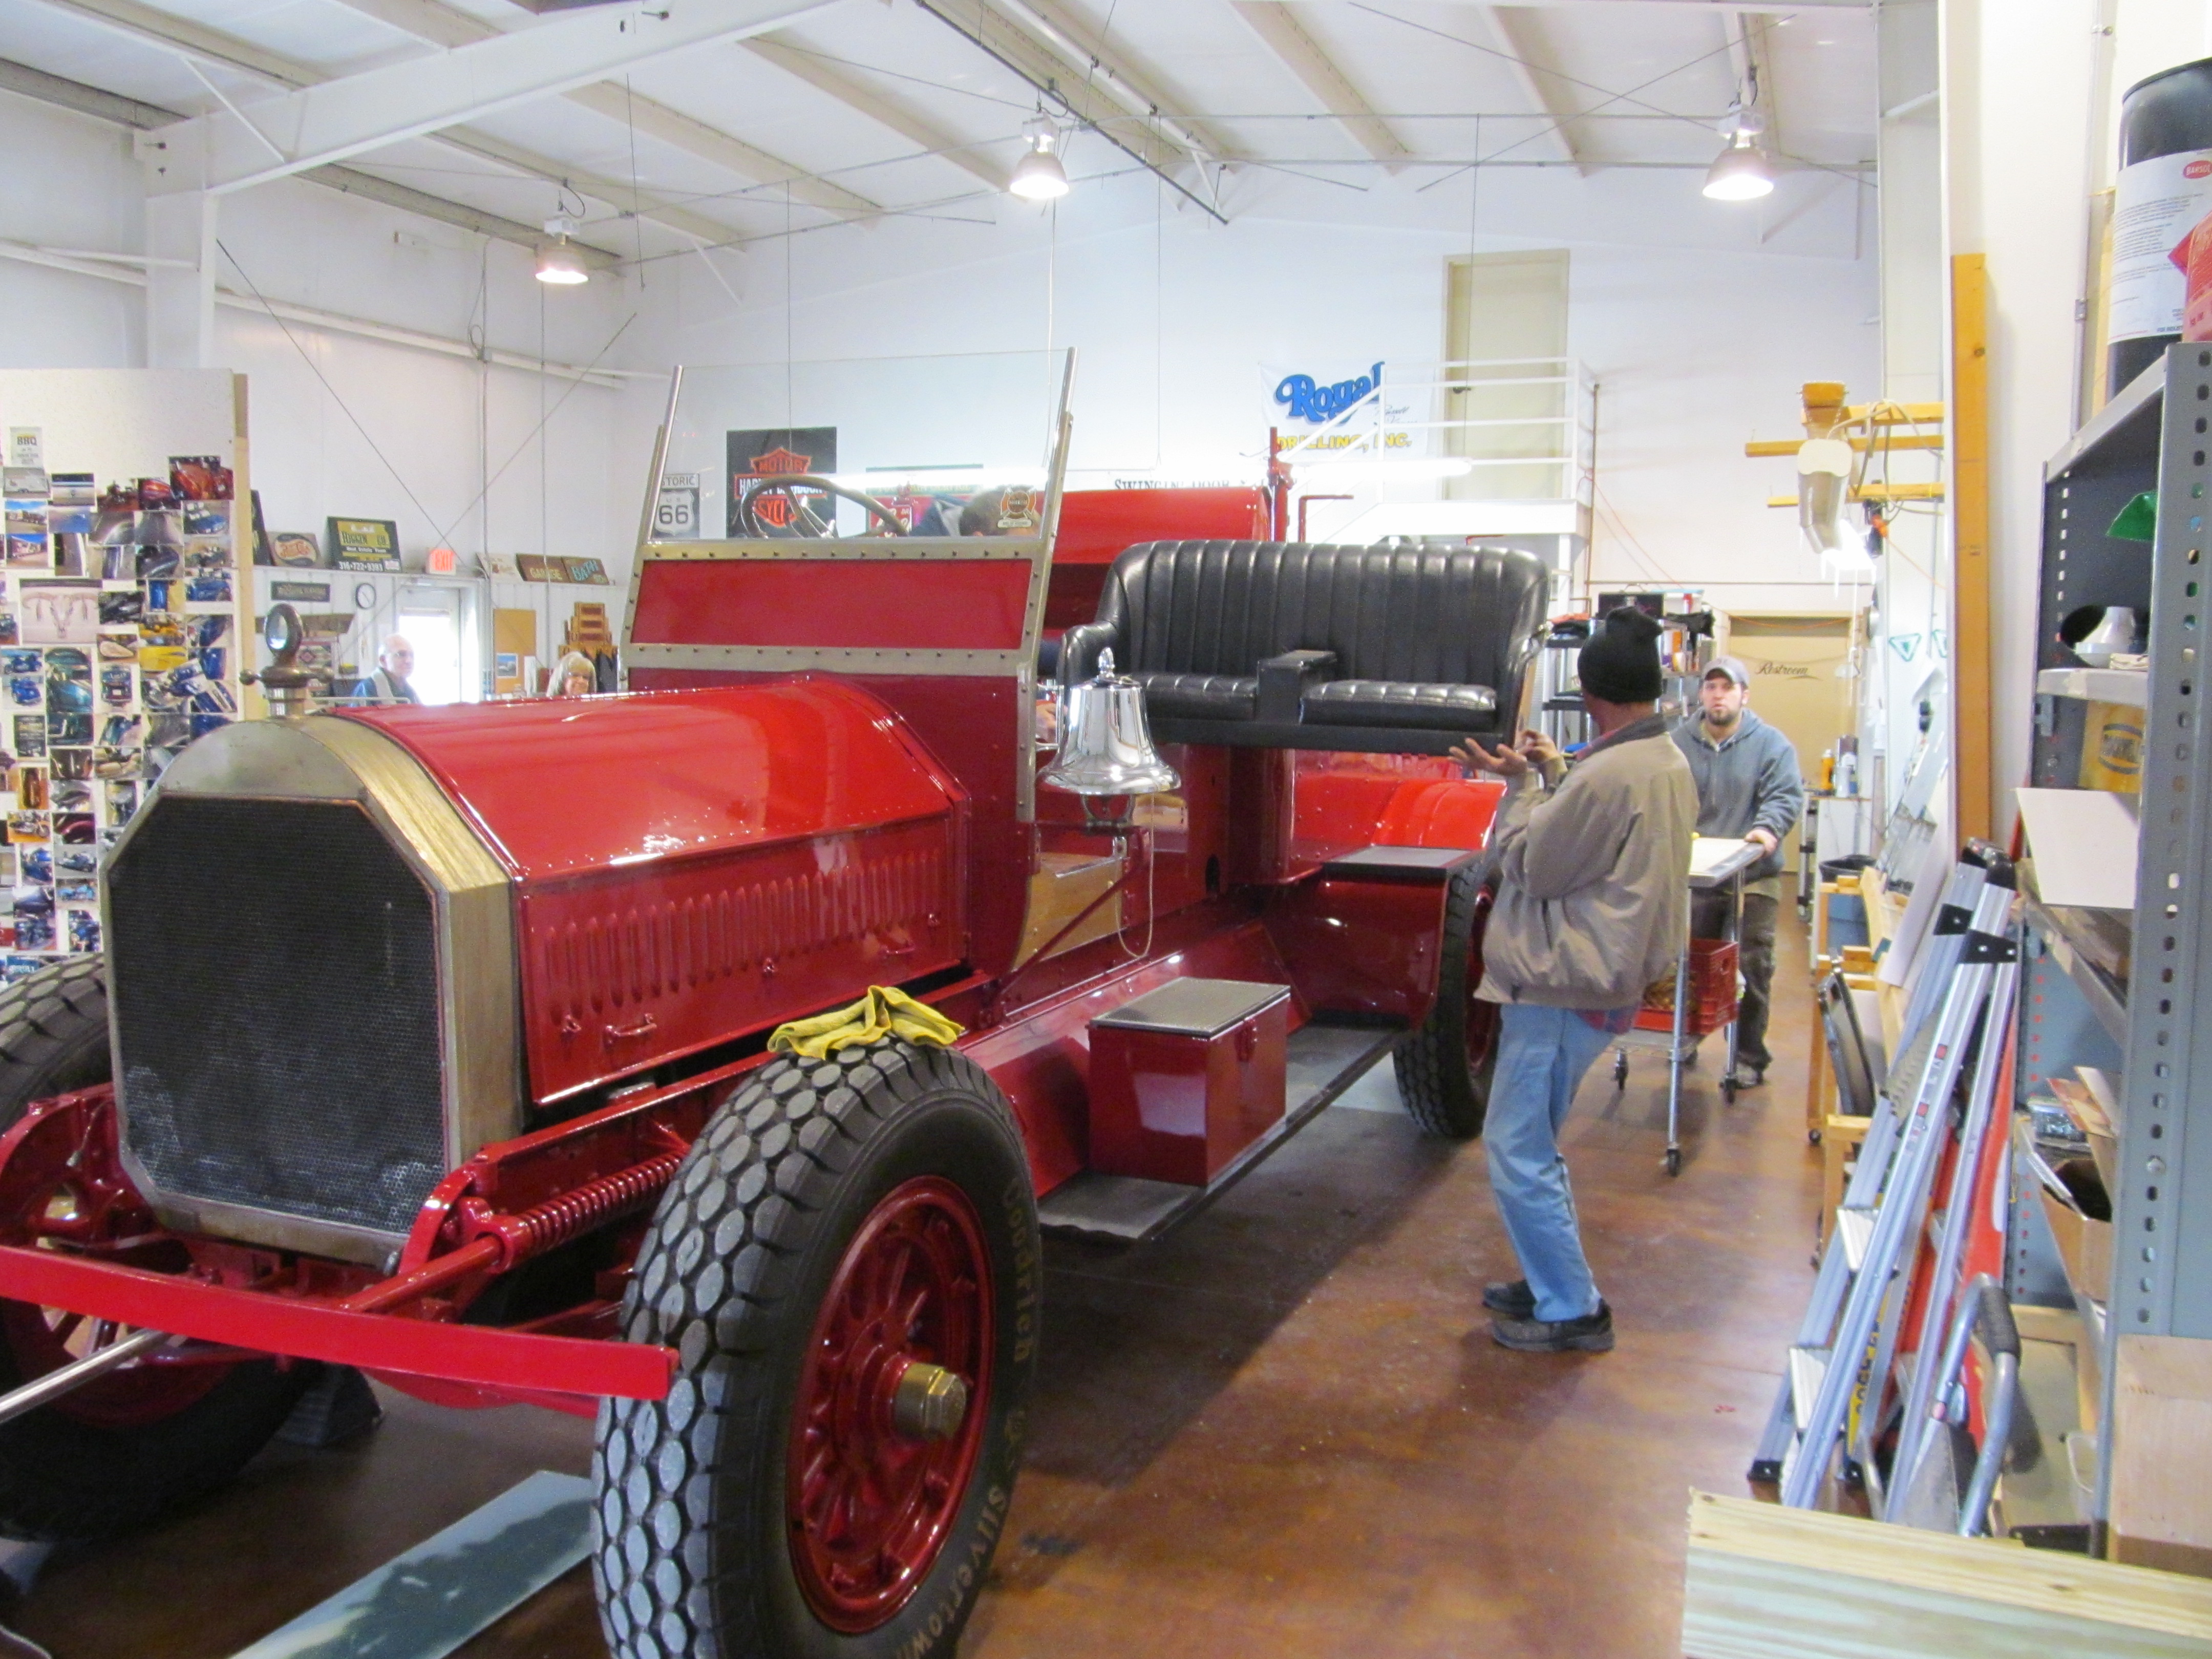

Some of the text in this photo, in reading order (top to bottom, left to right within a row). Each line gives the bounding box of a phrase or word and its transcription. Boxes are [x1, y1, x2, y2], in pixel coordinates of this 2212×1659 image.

[1275, 360, 1386, 424] Royal
[658, 504, 688, 524] 66
[432, 550, 452, 571] EXIT
[1755, 661, 1809, 675] Restroom
